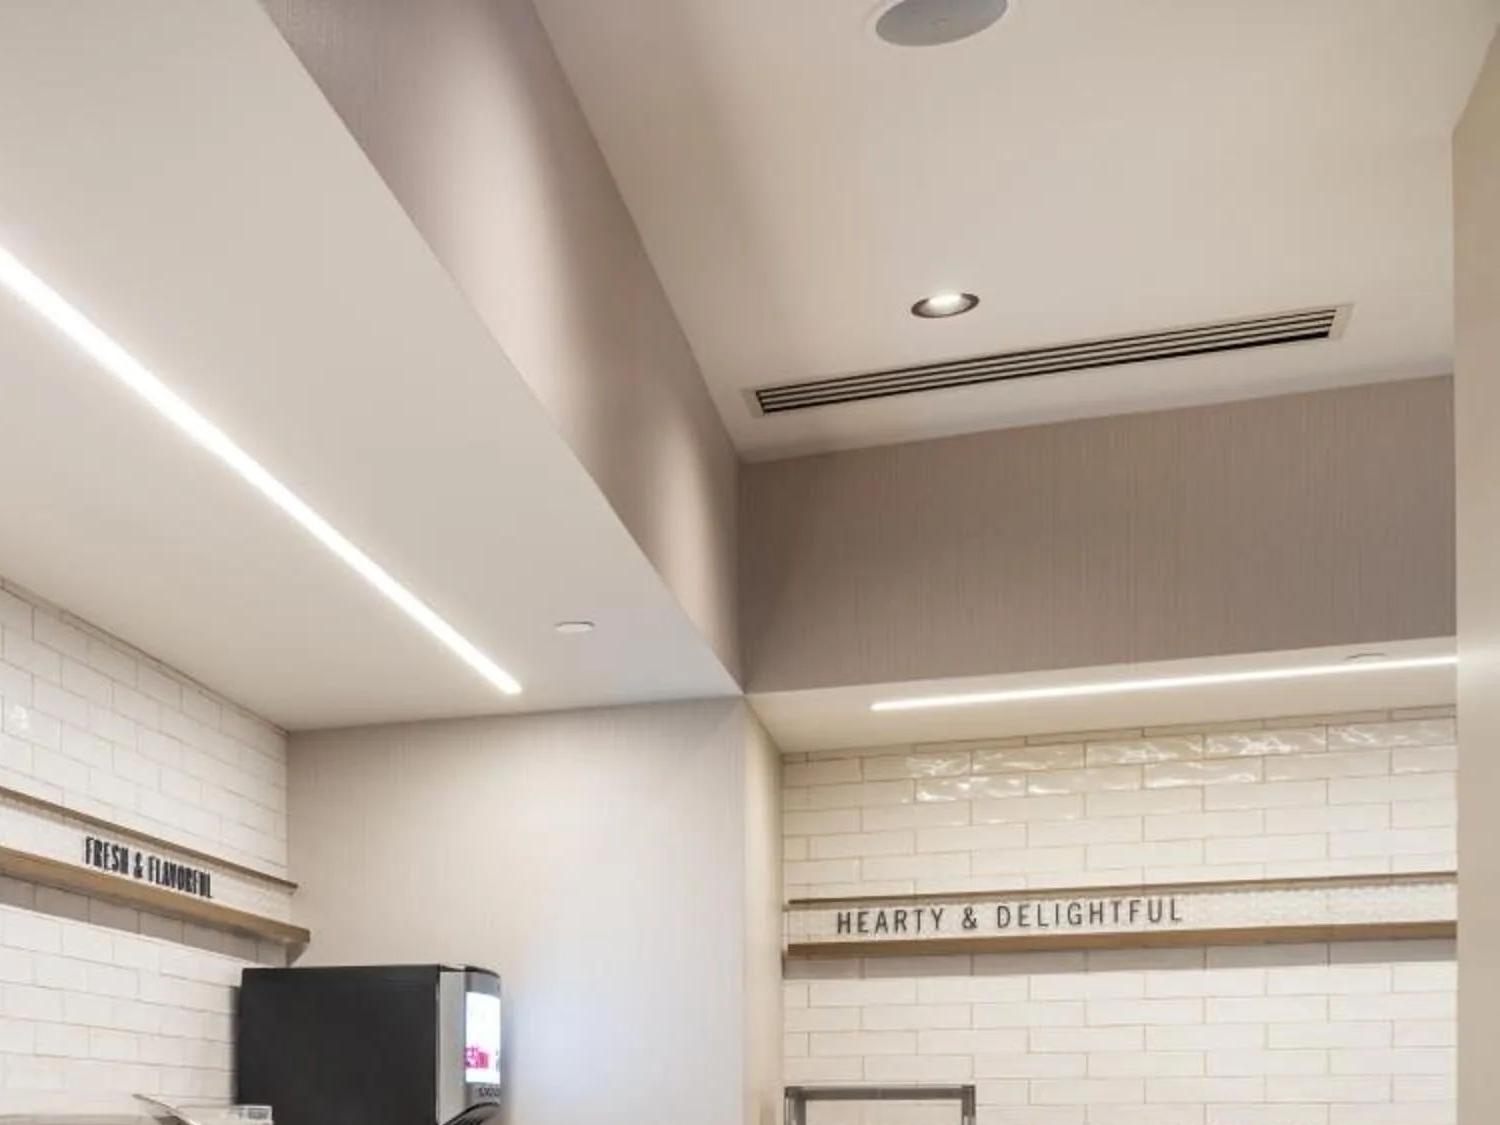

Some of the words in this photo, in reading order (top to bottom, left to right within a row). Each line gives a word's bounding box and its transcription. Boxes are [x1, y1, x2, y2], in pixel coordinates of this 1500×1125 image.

[85, 836, 129, 875] FRESH
[134, 852, 143, 878] &
[837, 908, 945, 935] HEARTY
[962, 906, 978, 930] &
[997, 898, 1184, 930] DELIGHTFUL
